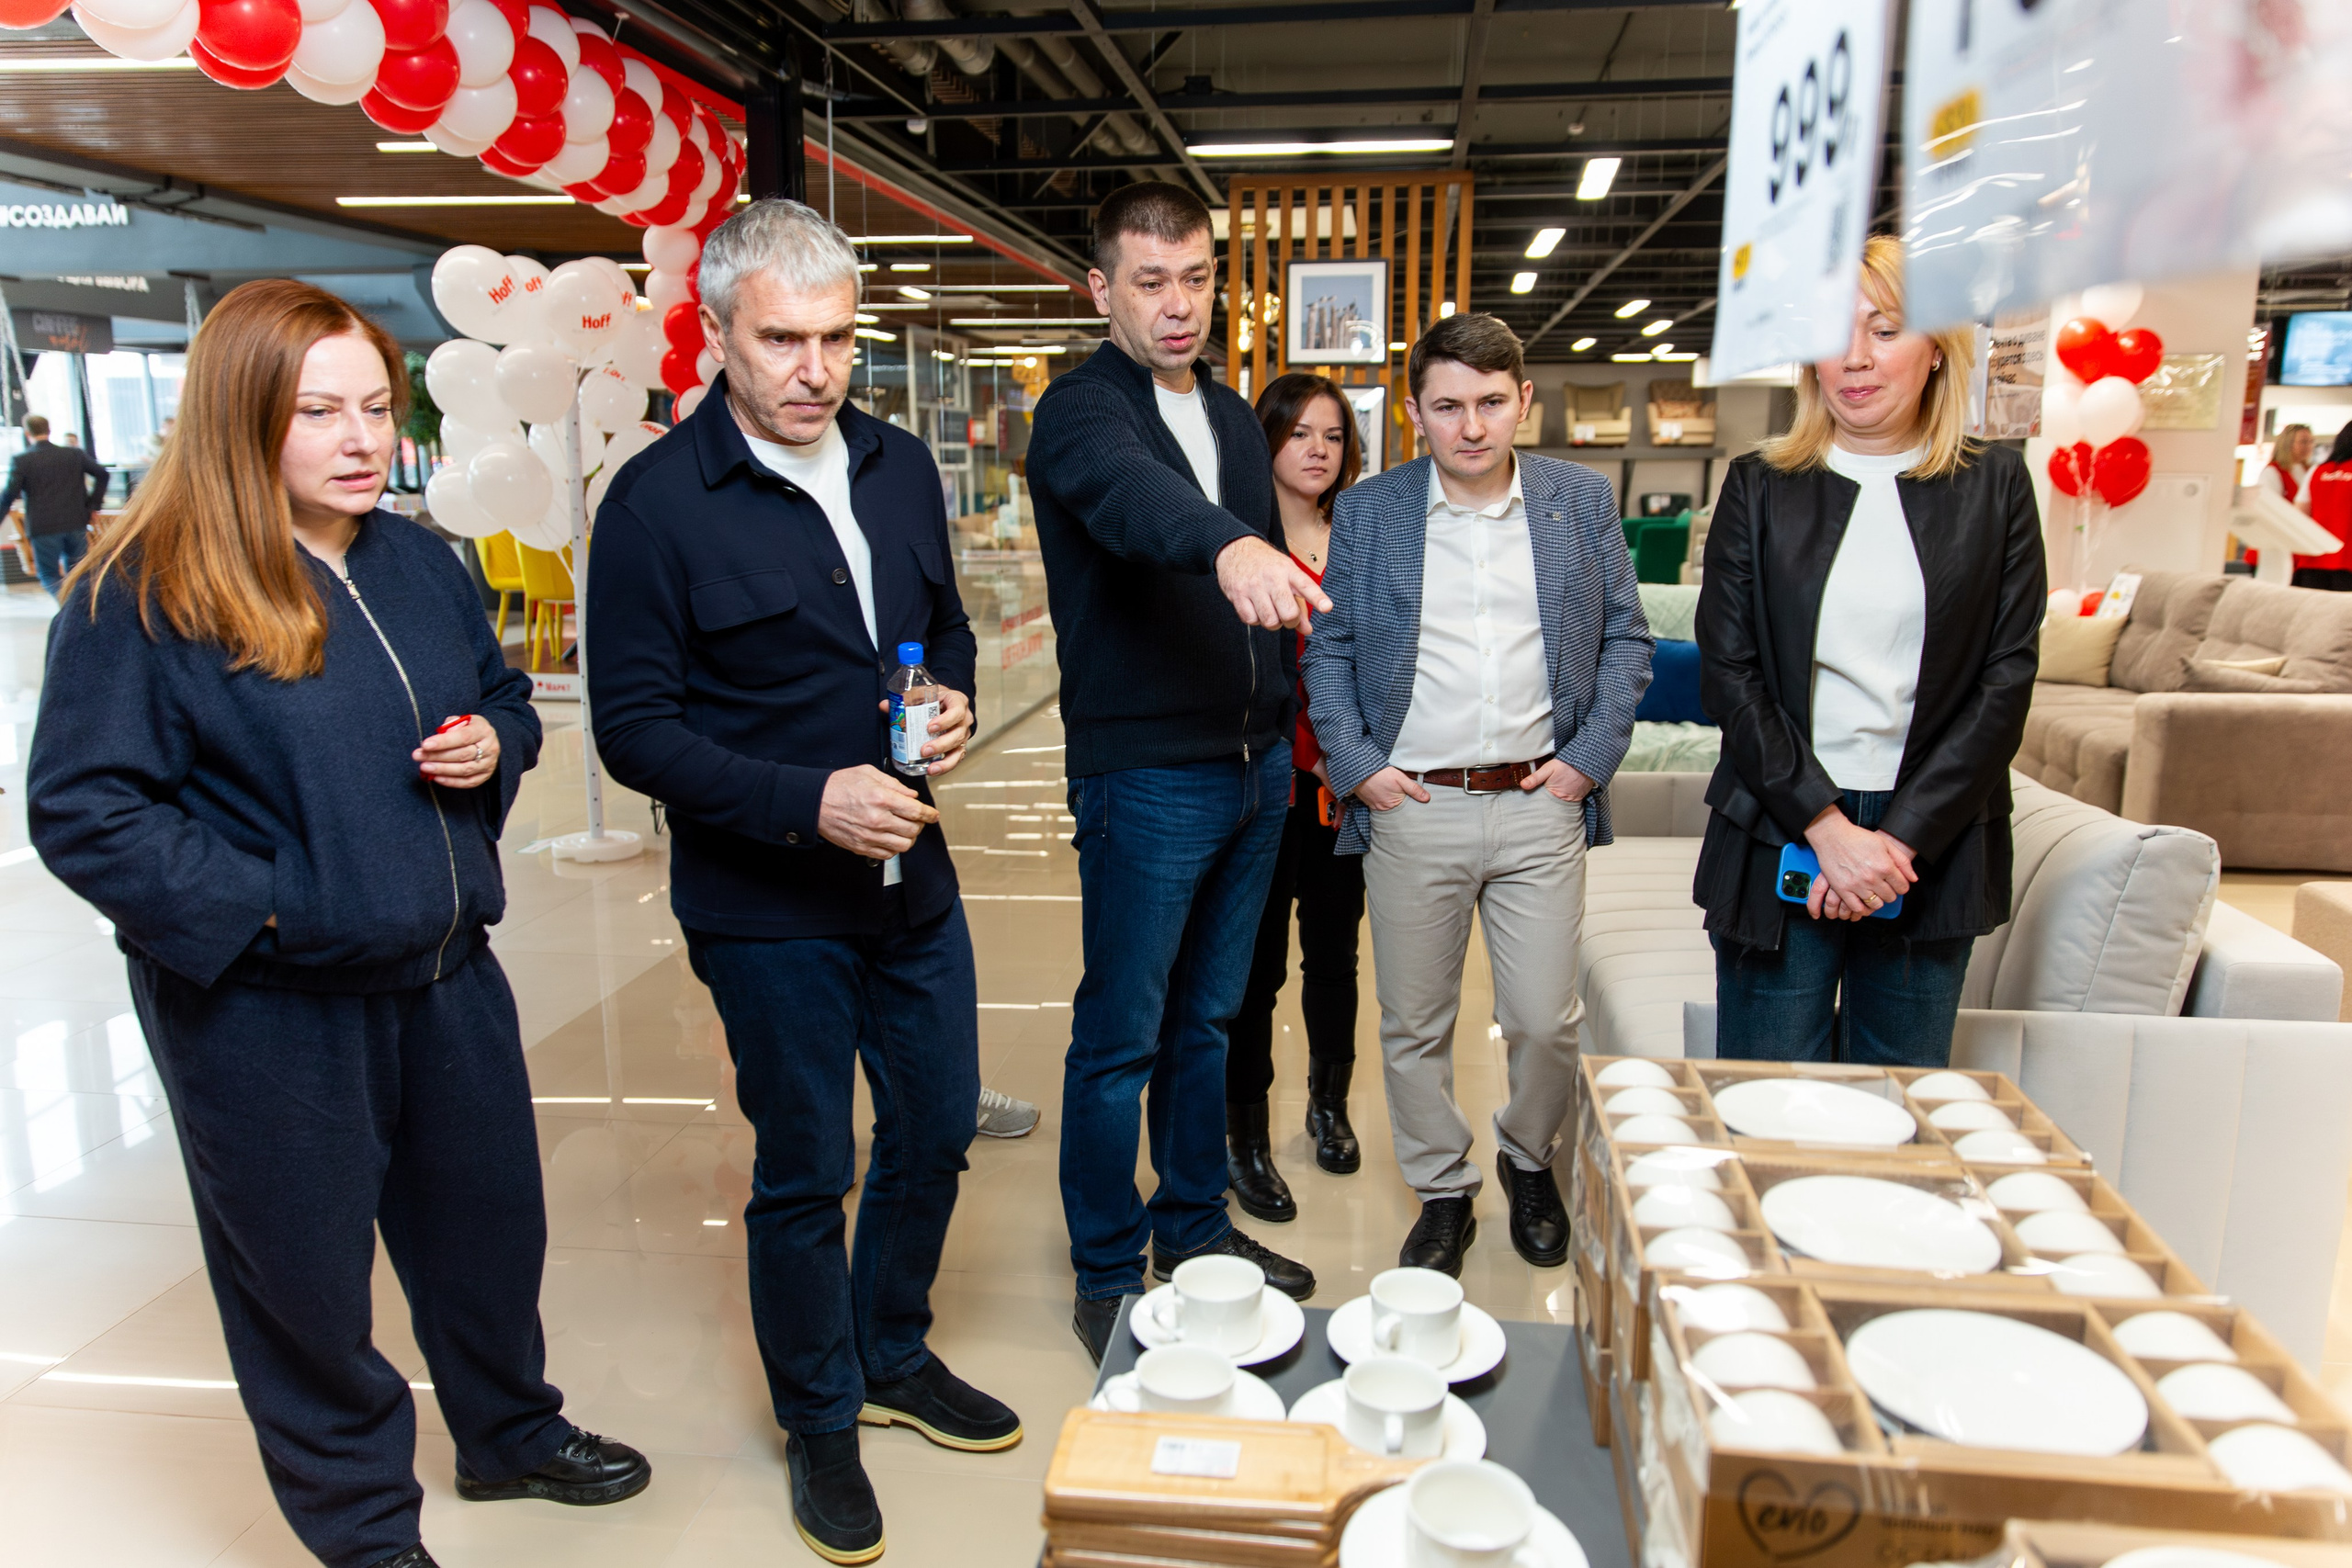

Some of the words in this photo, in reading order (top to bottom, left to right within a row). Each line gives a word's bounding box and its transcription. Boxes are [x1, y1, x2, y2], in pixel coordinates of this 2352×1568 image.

[1770, 28, 1851, 205] 999
[488, 275, 515, 305] Hoff
[525, 276, 544, 293] off
[582, 312, 612, 329] Hoff
